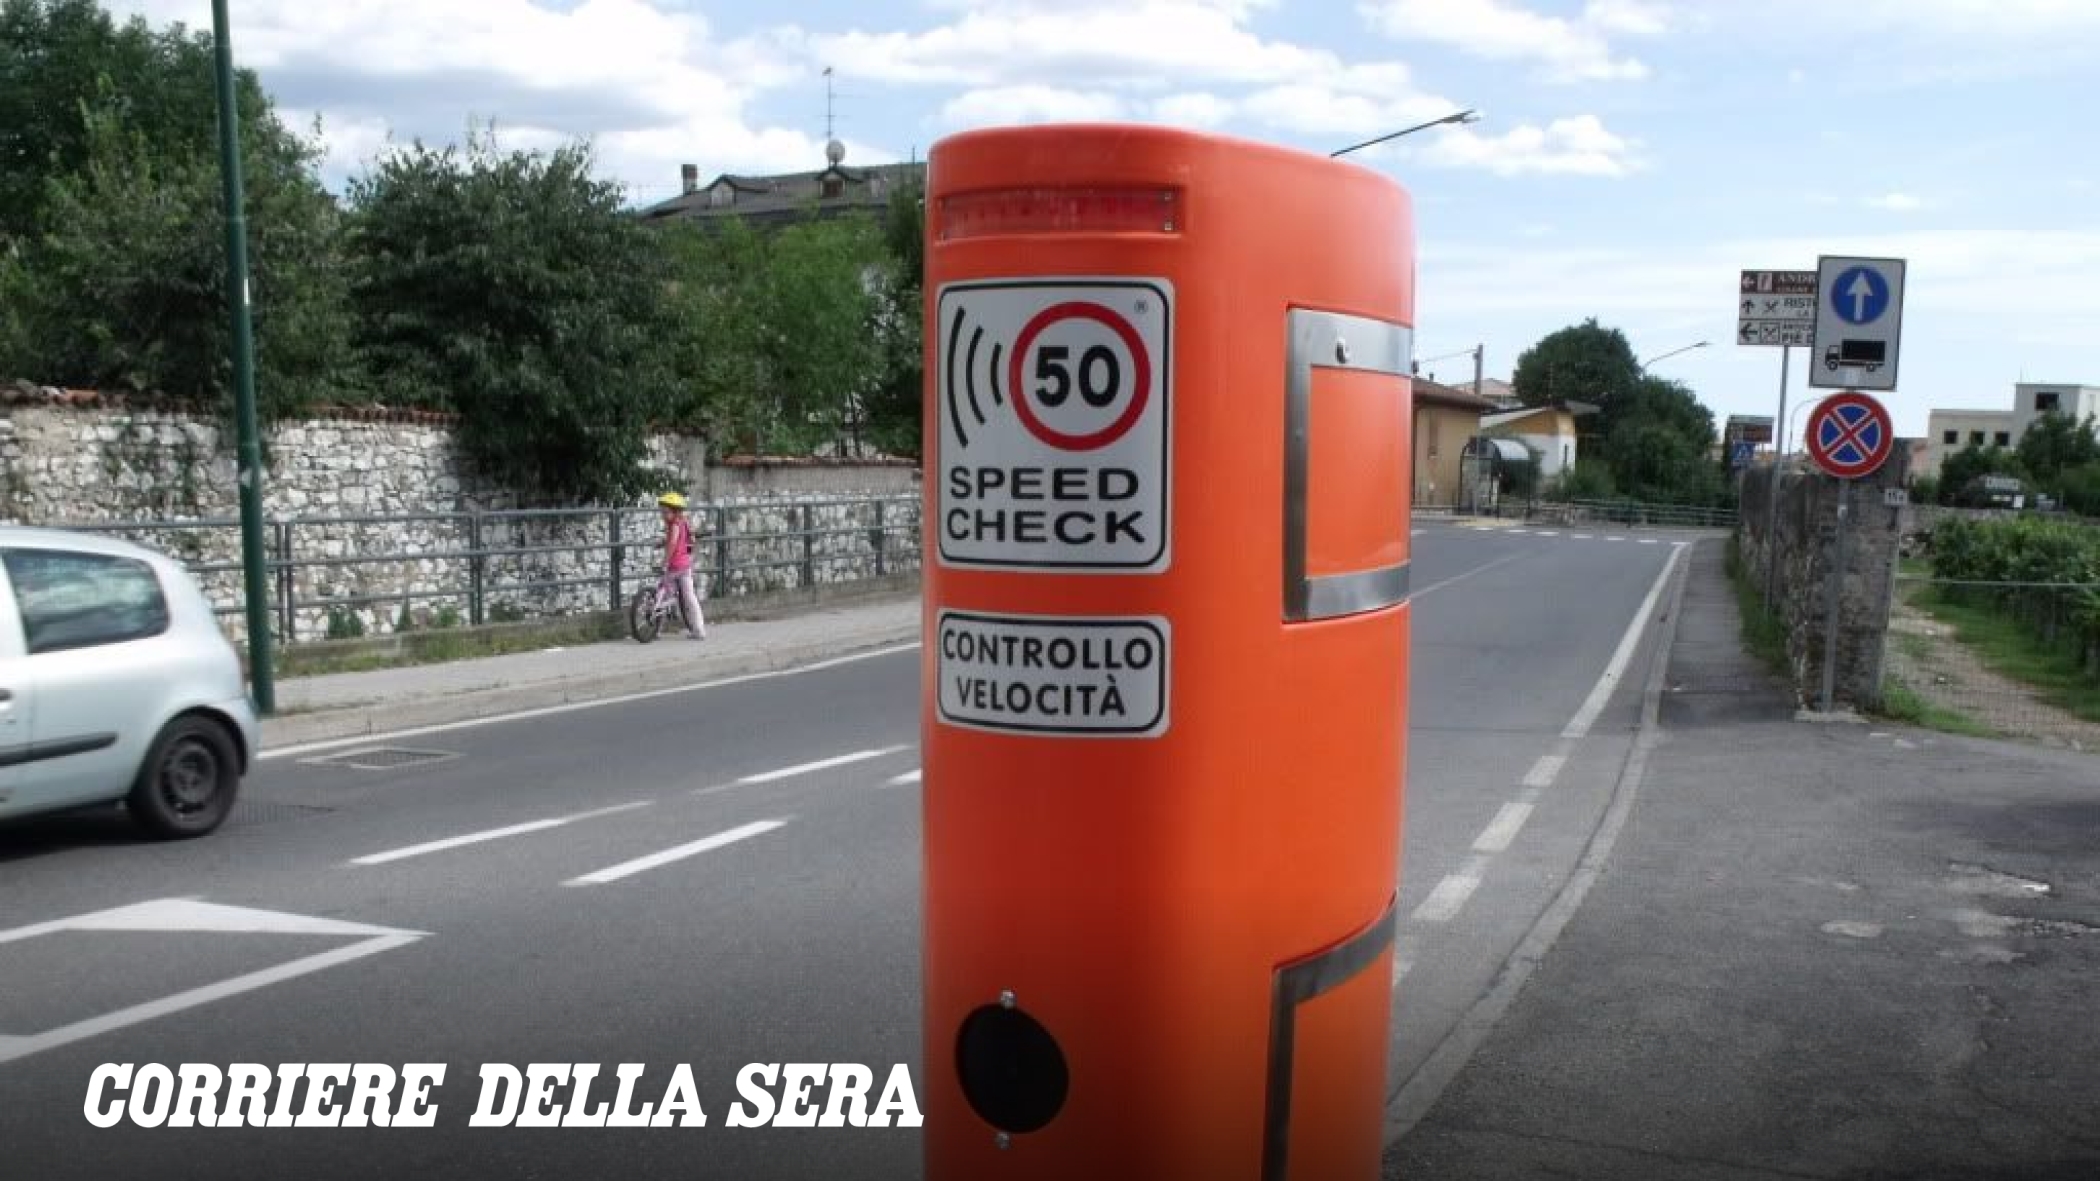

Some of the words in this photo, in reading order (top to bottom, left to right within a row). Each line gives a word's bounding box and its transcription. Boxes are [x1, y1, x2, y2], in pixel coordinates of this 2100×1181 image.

[1035, 345, 1120, 408] 50
[949, 466, 1139, 501] SPEED
[947, 508, 1146, 545] CHECK
[943, 629, 1152, 670] CONTROLLO
[957, 674, 1126, 716] VELOCITÀ
